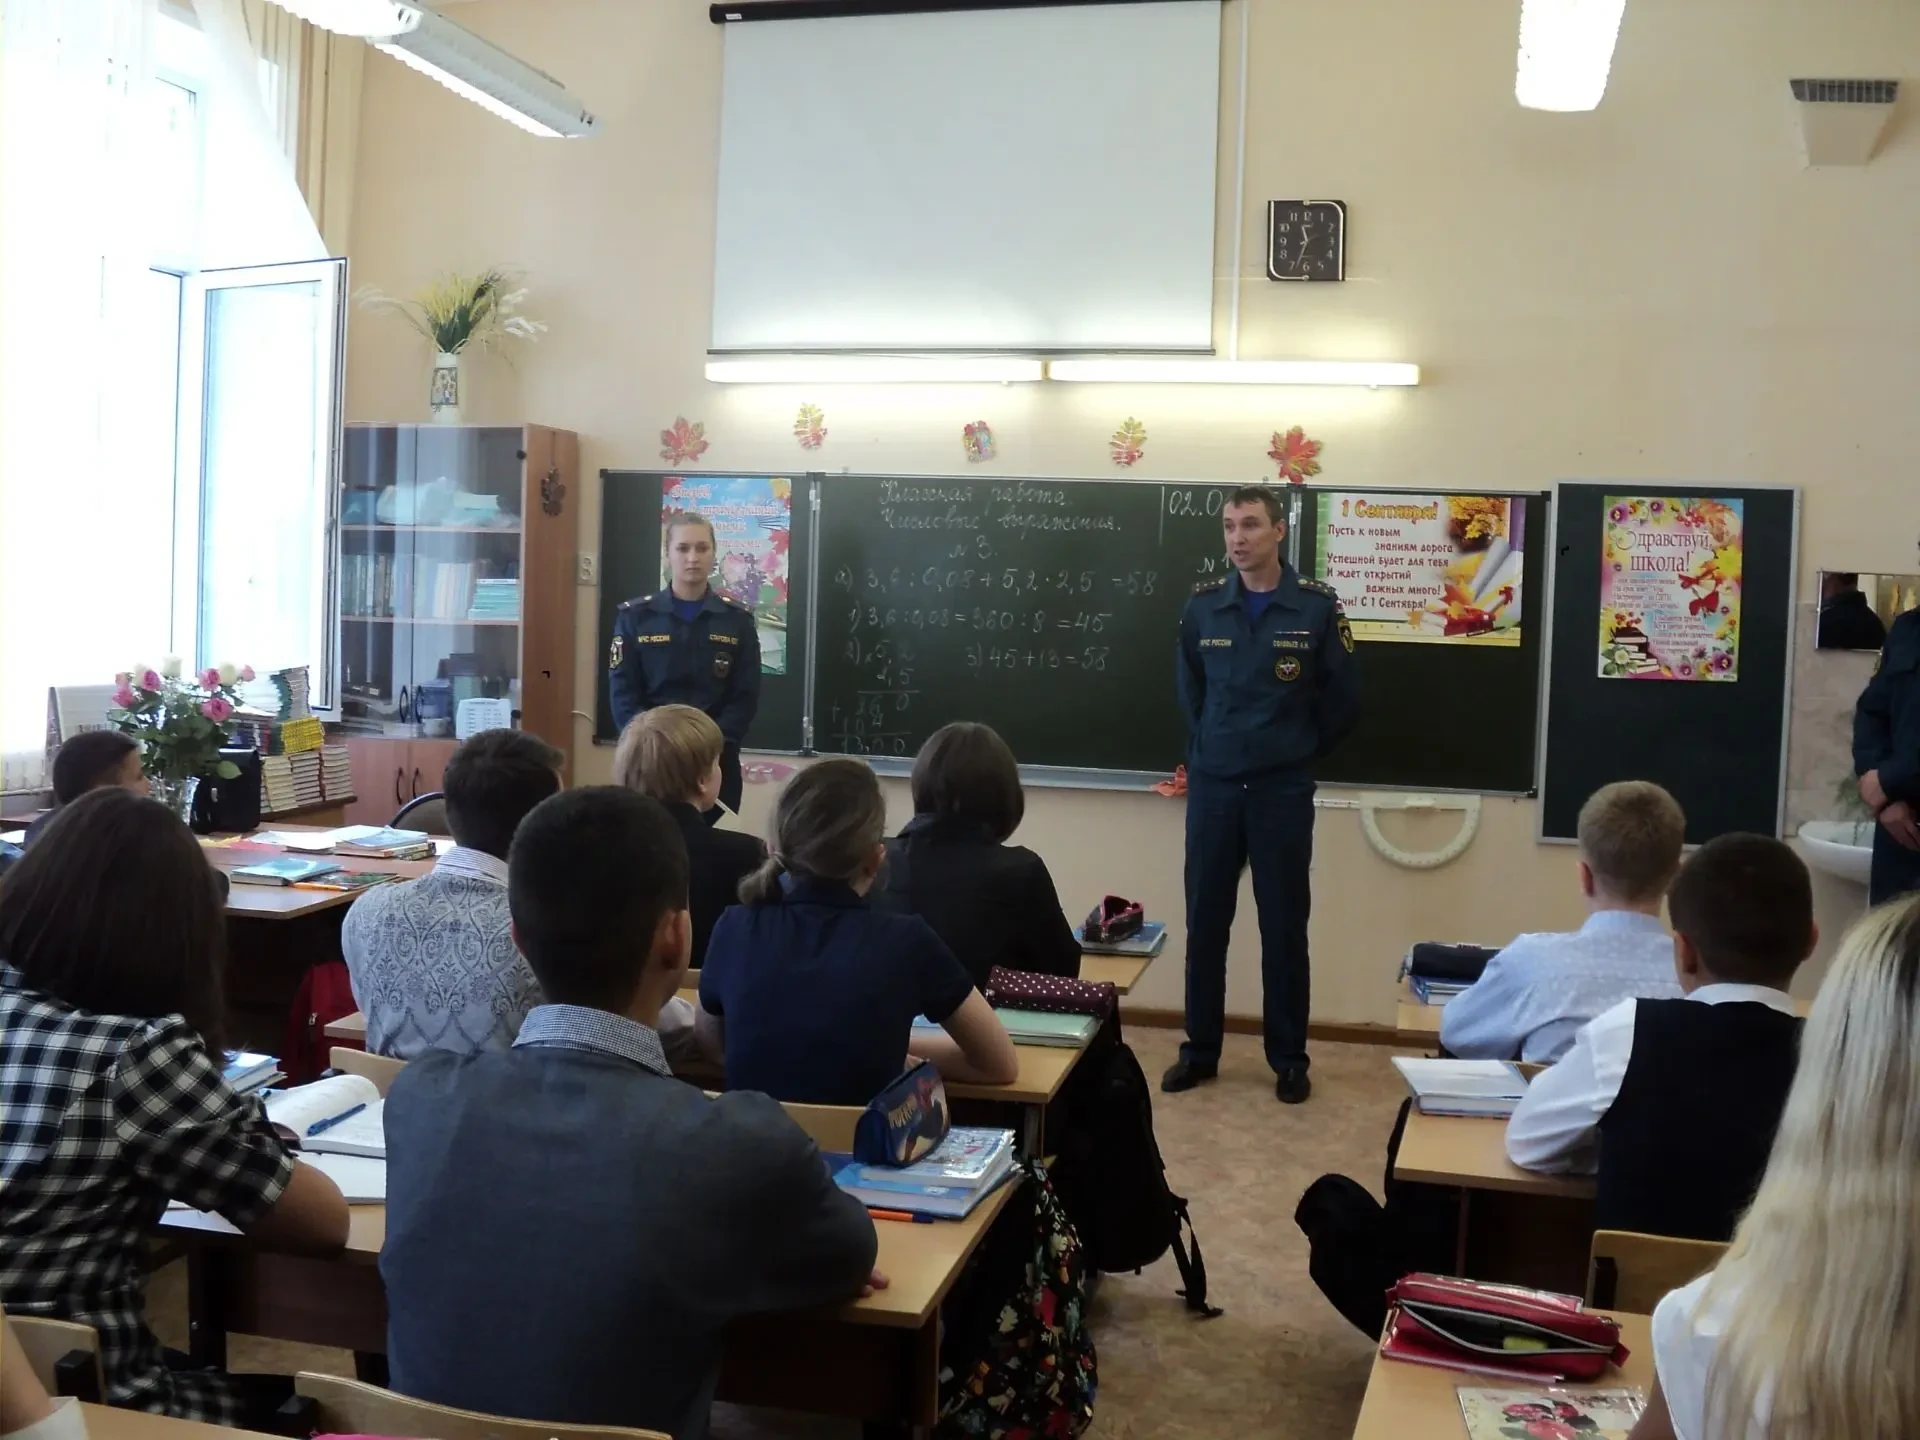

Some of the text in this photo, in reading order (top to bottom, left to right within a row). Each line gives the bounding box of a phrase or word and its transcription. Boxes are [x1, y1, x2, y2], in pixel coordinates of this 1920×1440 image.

[1290, 211, 1298, 222] 11
[1320, 212, 1324, 222] 1
[1328, 222, 1334, 233] 2
[1280, 237, 1287, 246] 9
[1280, 249, 1287, 260] 8
[1327, 249, 1333, 260] 4
[1289, 260, 1296, 271] 7
[1302, 261, 1310, 272] 6
[1169, 489, 1224, 516] 02.0
[1342, 499, 1439, 524] 1 Сентября!
[1328, 524, 1400, 537] Пусть к новым
[1375, 542, 1453, 555] знаниям дорога
[1327, 552, 1375, 565] Успешной
[1408, 558, 1424, 566] для
[1428, 558, 1449, 567] тебя
[1631, 552, 1690, 572] школа!
[1327, 567, 1333, 577] И
[1365, 570, 1412, 582] открытий
[1366, 585, 1441, 596] важных много!
[1361, 596, 1368, 607] С
[1371, 597, 1375, 607] 1
[1379, 597, 1427, 612] Сентября!
